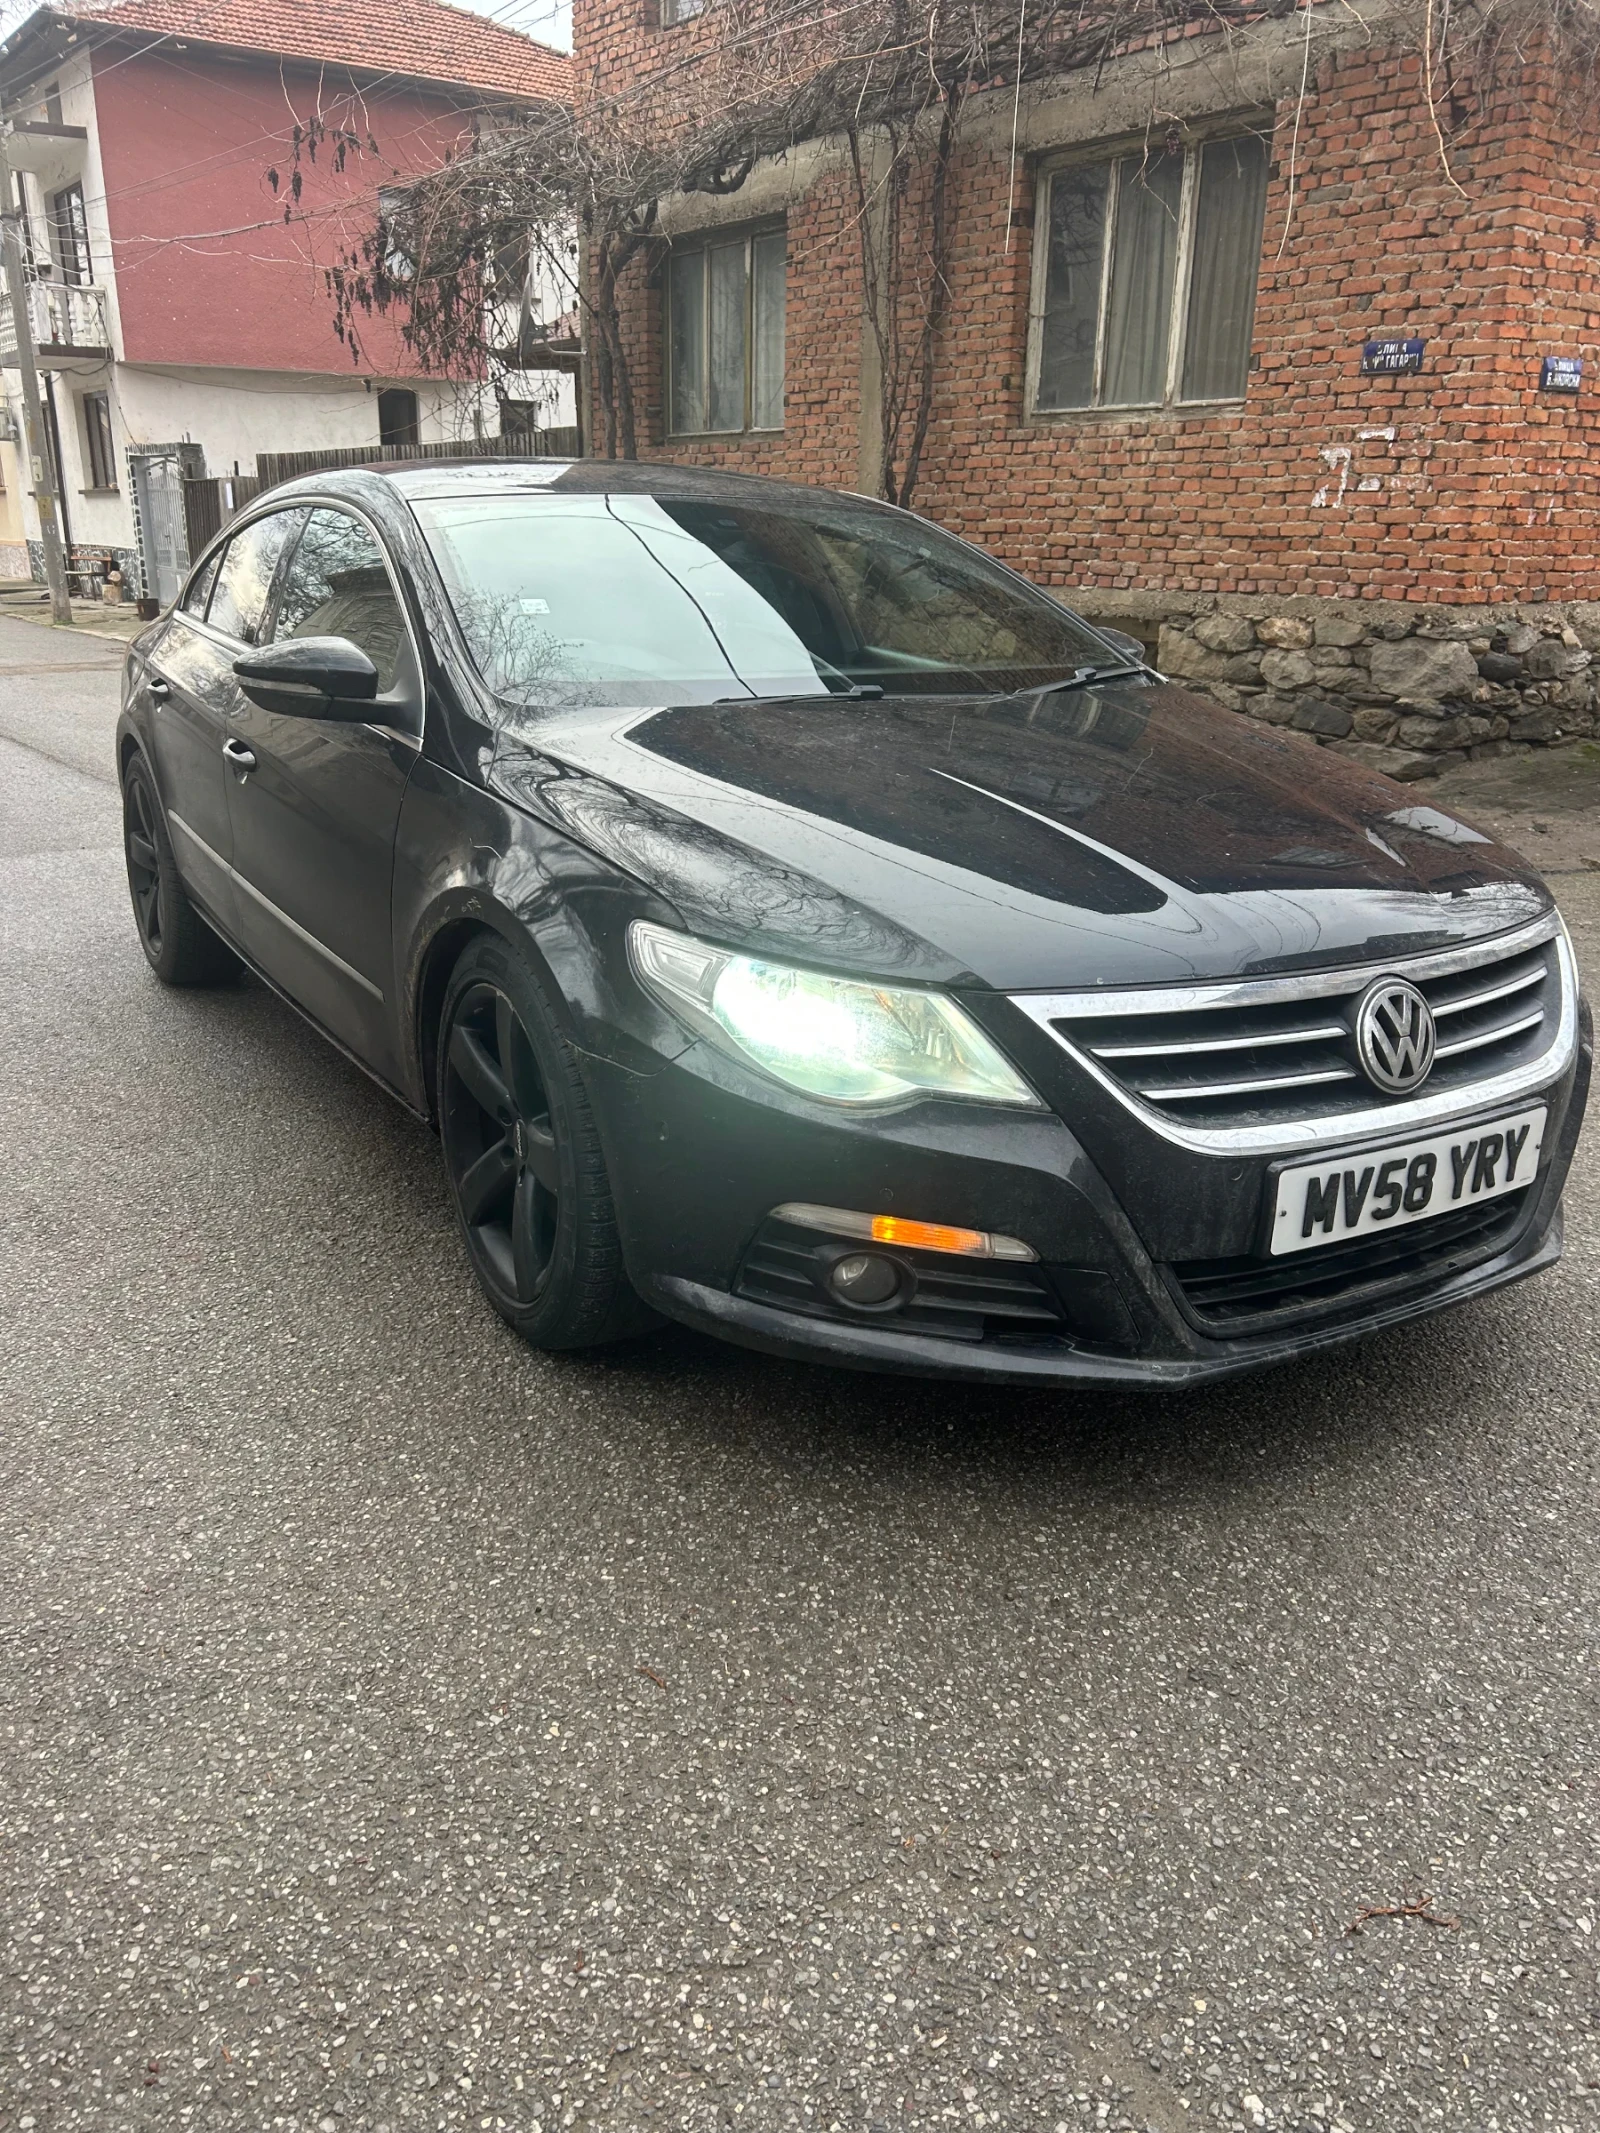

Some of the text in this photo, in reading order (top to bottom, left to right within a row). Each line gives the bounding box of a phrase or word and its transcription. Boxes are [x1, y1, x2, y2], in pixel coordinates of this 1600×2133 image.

[1385, 353, 1419, 368] ГАГАР
[1302, 1124, 1531, 1237] MV58 YRY
